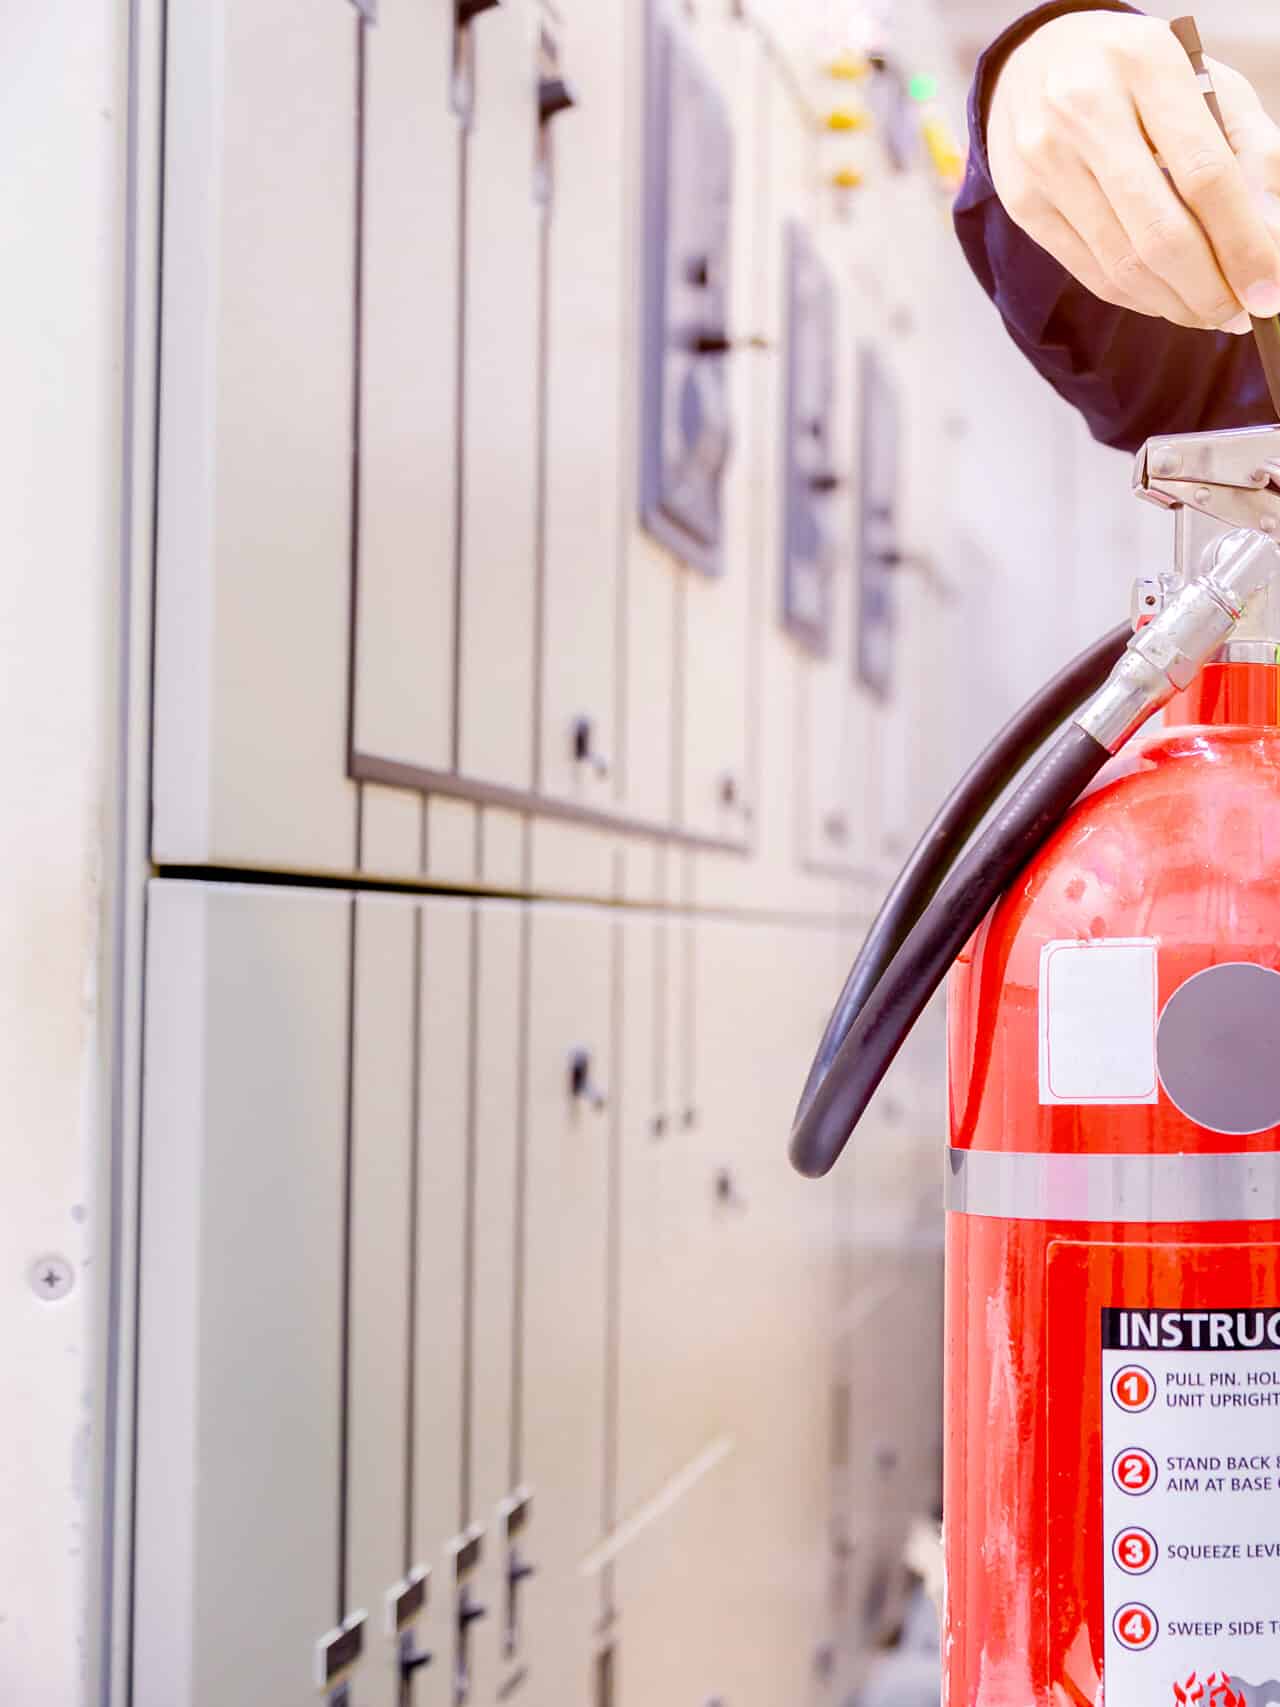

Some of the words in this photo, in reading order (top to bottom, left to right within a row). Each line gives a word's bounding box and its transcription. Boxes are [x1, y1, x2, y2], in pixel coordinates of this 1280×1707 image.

[1166, 1372, 1205, 1387] PULL
[1210, 1372, 1241, 1387] PIN.
[1124, 1376, 1139, 1401] 1
[1166, 1393, 1207, 1408] UNIT
[1167, 1456, 1221, 1471] STAND
[1227, 1455, 1271, 1470] BACK
[1124, 1459, 1144, 1484] 2
[1167, 1478, 1200, 1492] AIM
[1205, 1477, 1225, 1491] AT
[1232, 1476, 1272, 1491] BASE
[1124, 1538, 1144, 1564] 3
[1167, 1544, 1241, 1561] SQUEEZE
[1125, 1614, 1144, 1640] 4
[1168, 1622, 1223, 1636] SWEEP
[1228, 1621, 1264, 1635] SIDE
